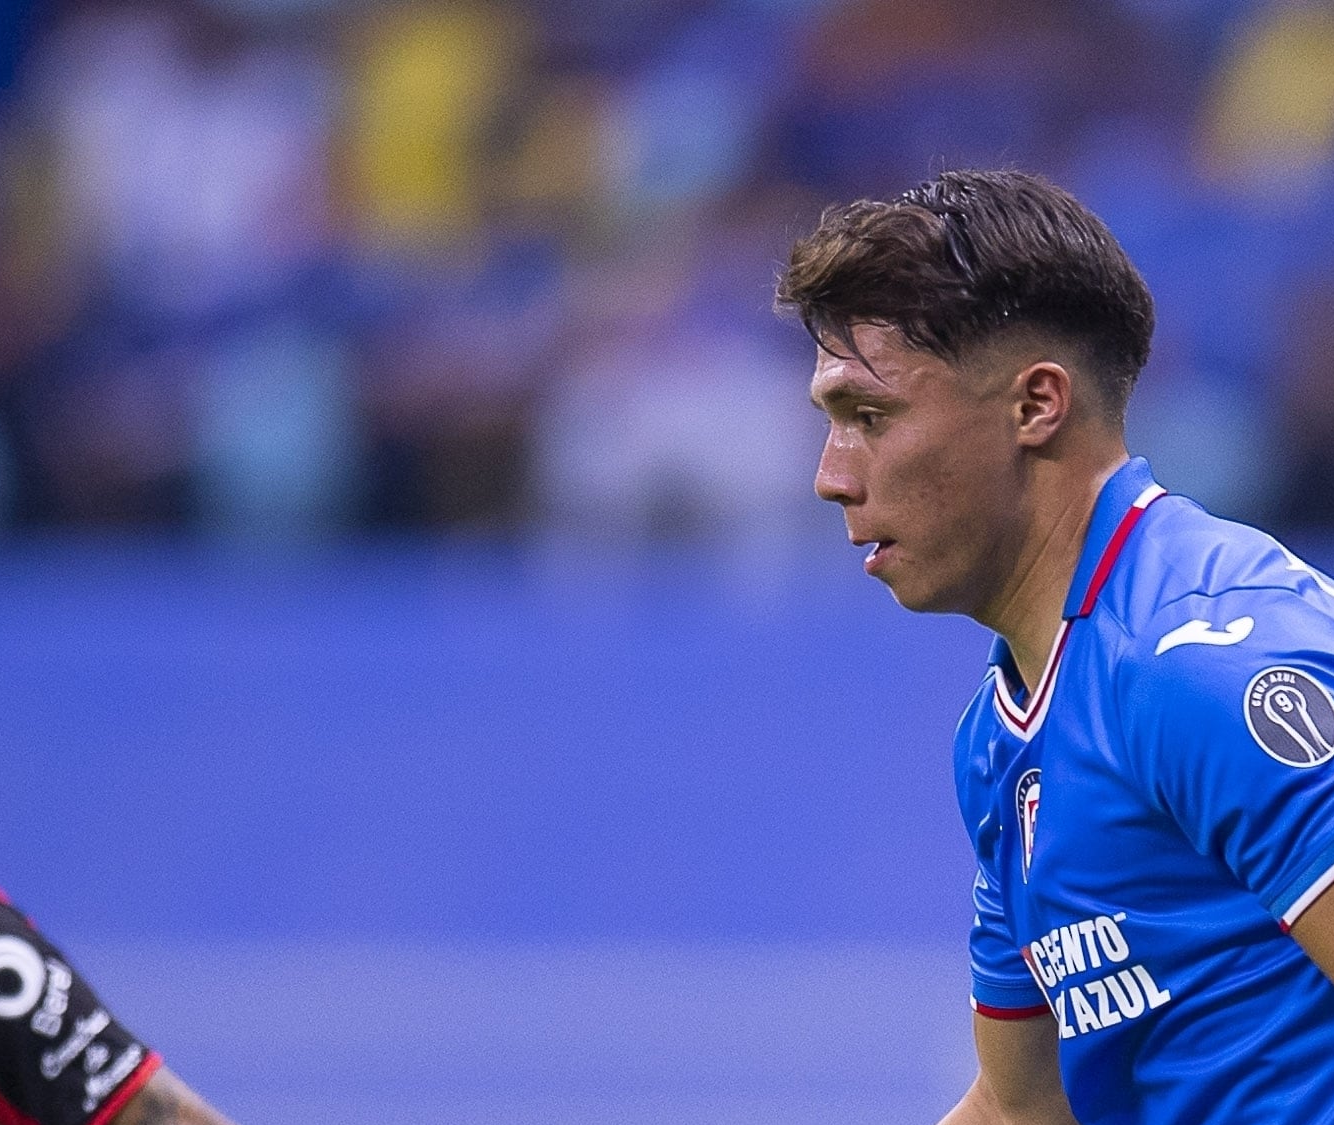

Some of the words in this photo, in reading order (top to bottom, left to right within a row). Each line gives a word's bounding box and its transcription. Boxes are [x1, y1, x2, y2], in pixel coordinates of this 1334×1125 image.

[1269, 672, 1296, 684] AZUL
[1274, 692, 1294, 713] 9
[1069, 964, 1171, 1035] AZUL
